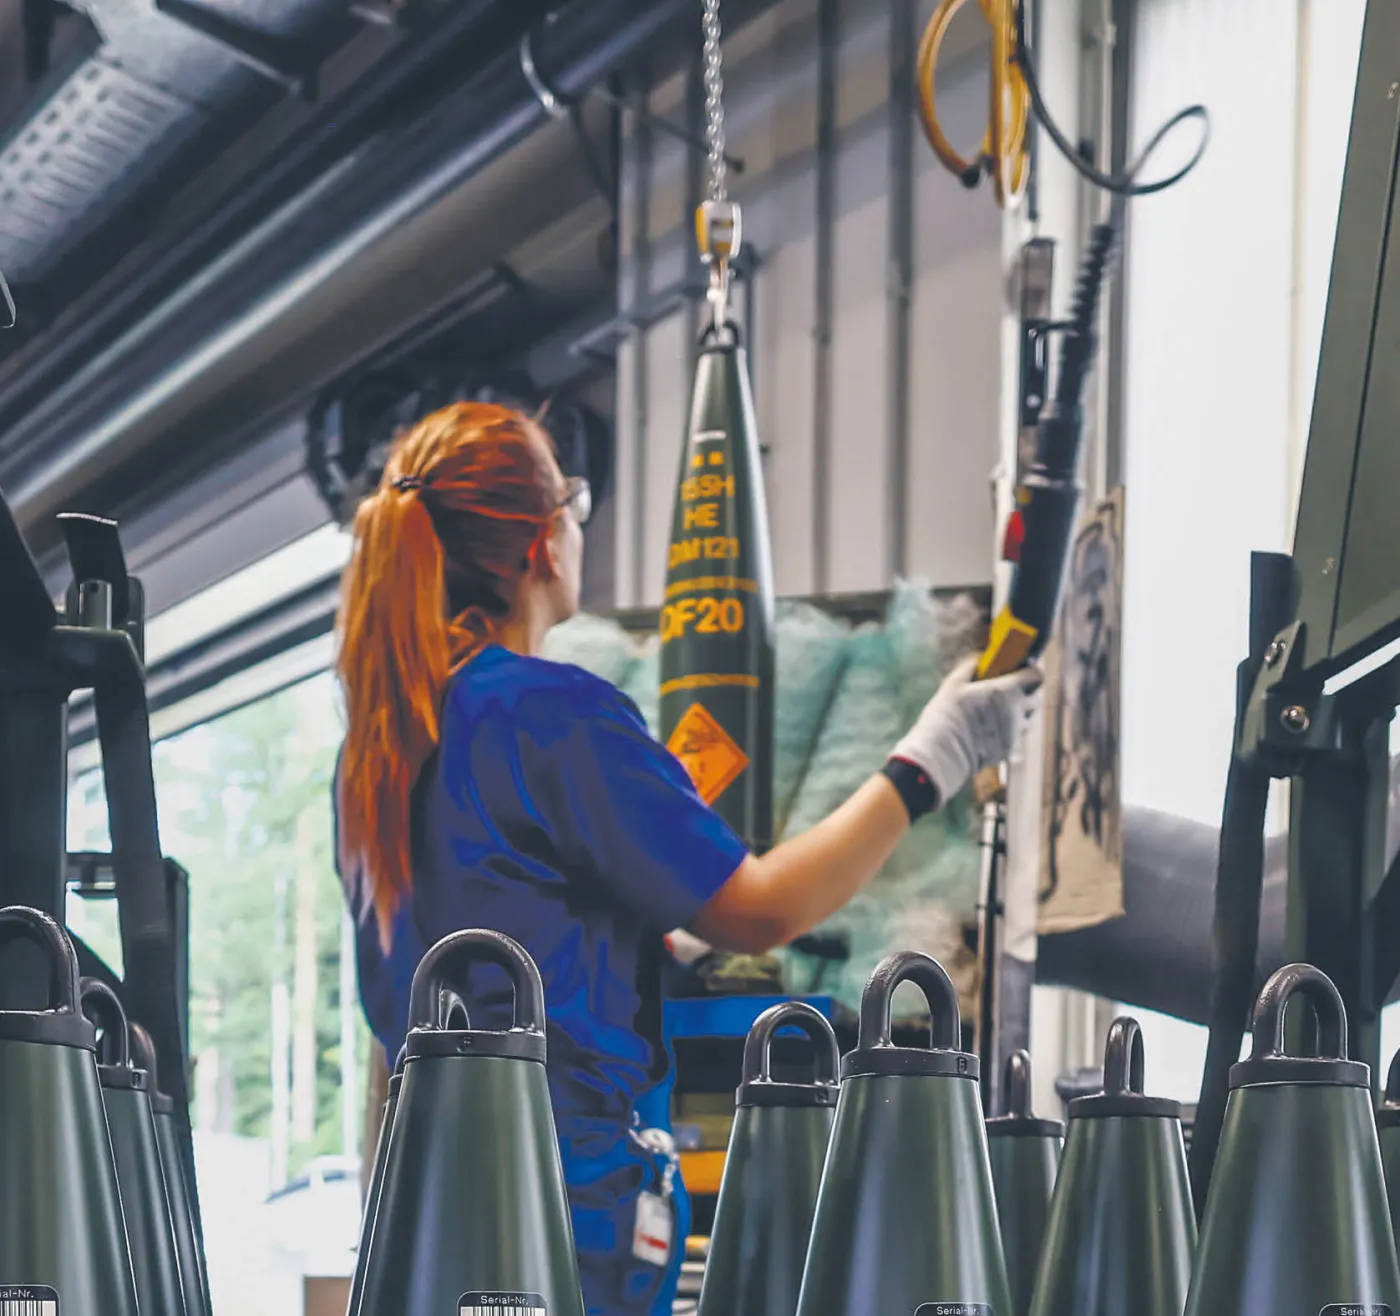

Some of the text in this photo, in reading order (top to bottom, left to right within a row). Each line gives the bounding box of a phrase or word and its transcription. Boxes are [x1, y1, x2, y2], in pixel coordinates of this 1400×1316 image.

[684, 503, 719, 530] HE
[659, 597, 744, 644] DF20
[480, 1295, 529, 1305] Serial-Nr.
